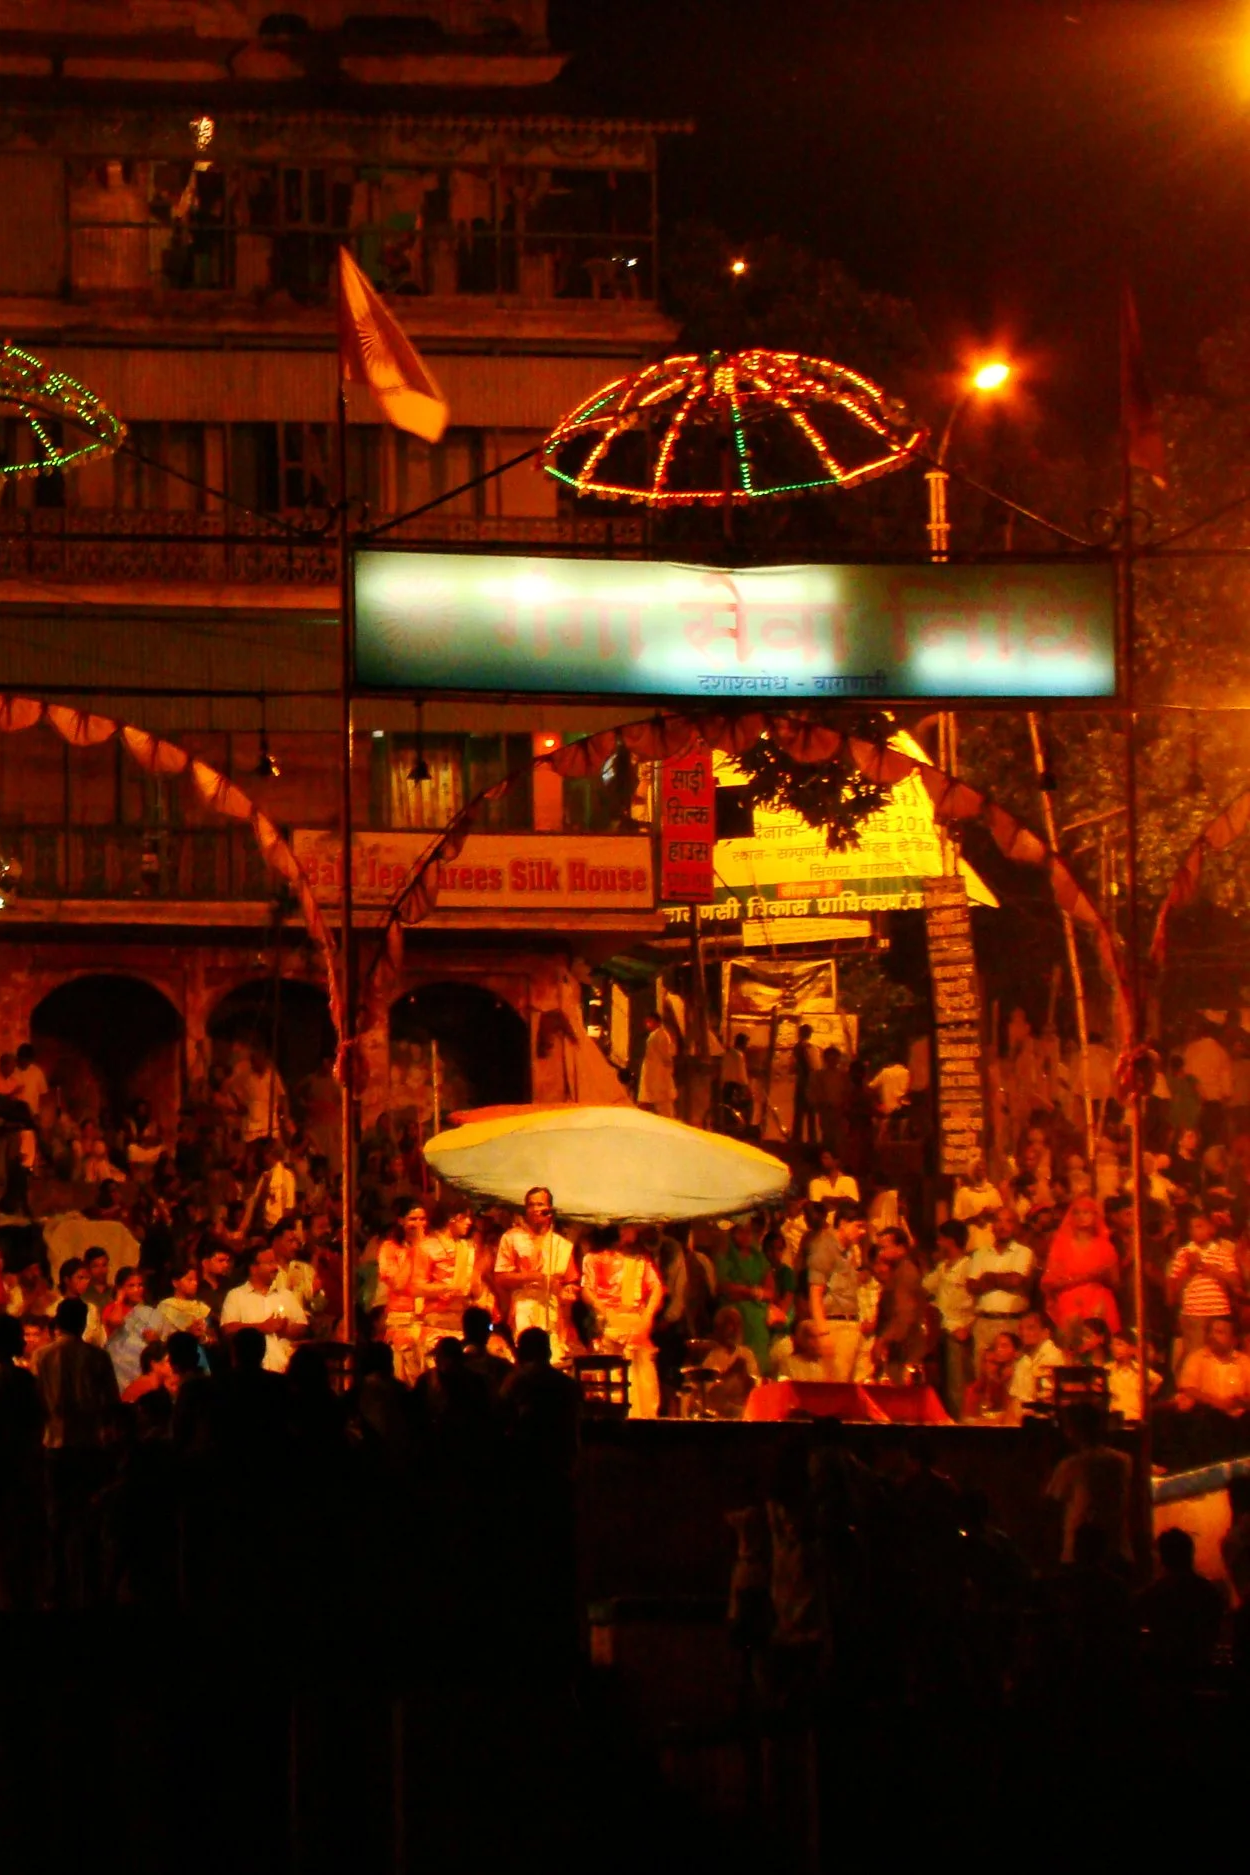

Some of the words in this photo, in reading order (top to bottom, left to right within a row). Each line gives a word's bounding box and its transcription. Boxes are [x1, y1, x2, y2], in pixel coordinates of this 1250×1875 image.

[679, 571, 856, 666] सेवा
[667, 796, 710, 825] सिल्क
[668, 841, 710, 863] हाउस
[509, 858, 561, 892] Silk
[569, 858, 647, 892] House
[747, 895, 812, 917] विकास
